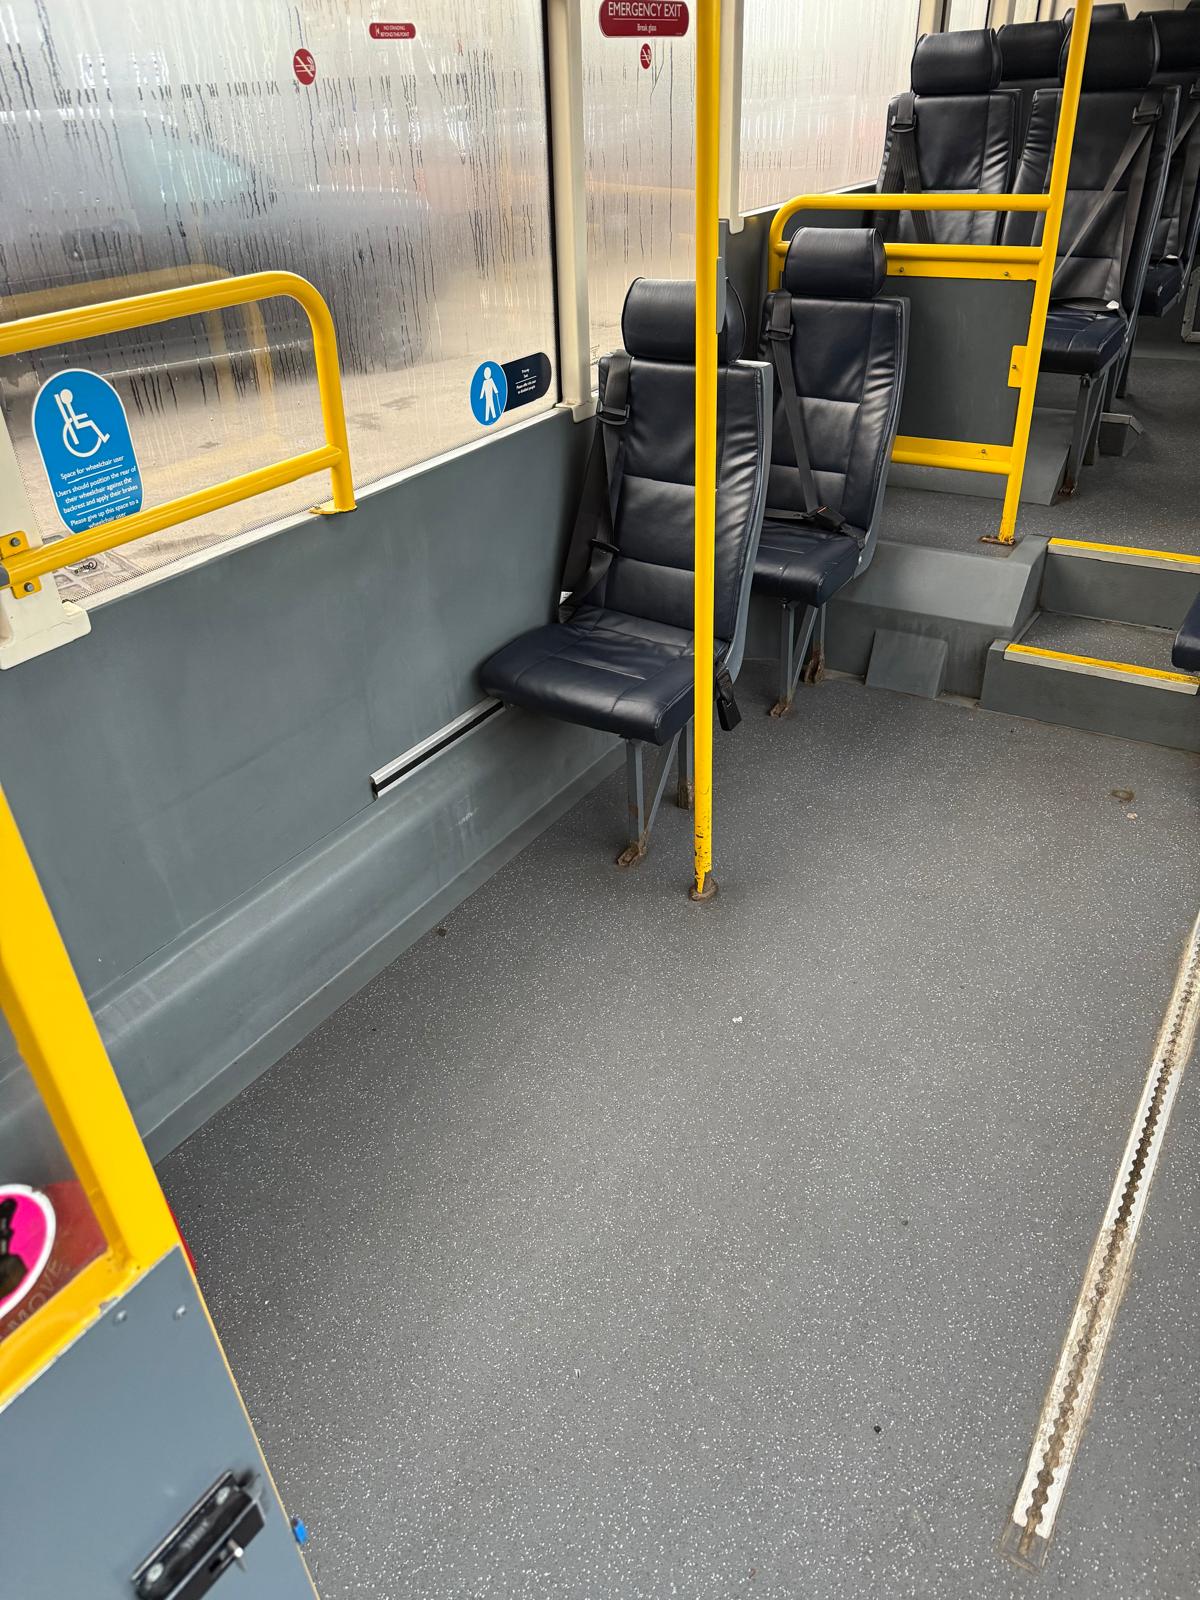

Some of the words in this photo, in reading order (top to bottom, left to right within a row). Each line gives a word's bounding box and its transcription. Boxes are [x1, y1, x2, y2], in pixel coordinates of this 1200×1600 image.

[608, 1, 662, 16] EMERGENCY
[663, 3, 682, 17] EXIT
[637, 23, 647, 31] Break
[648, 25, 657, 34] glass
[60, 470, 76, 480] Space
[76, 467, 85, 475] for
[85, 458, 112, 472] wheelchair
[113, 455, 124, 463] user
[56, 489, 71, 498] Users
[72, 481, 89, 493] should
[90, 475, 111, 488] position
[65, 496, 78, 504] their
[78, 486, 105, 499] wheelchair
[106, 481, 123, 491] against
[63, 503, 85, 514] backrest
[96, 494, 109, 504] apply
[110, 490, 122, 498] their
[122, 485, 138, 494] brakes
[70, 517, 87, 527] Please
[87, 513, 97, 523] give
[98, 511, 105, 519] up
[105, 506, 115, 515] this
[115, 503, 129, 513] space
[88, 515, 115, 529] wheelchair
